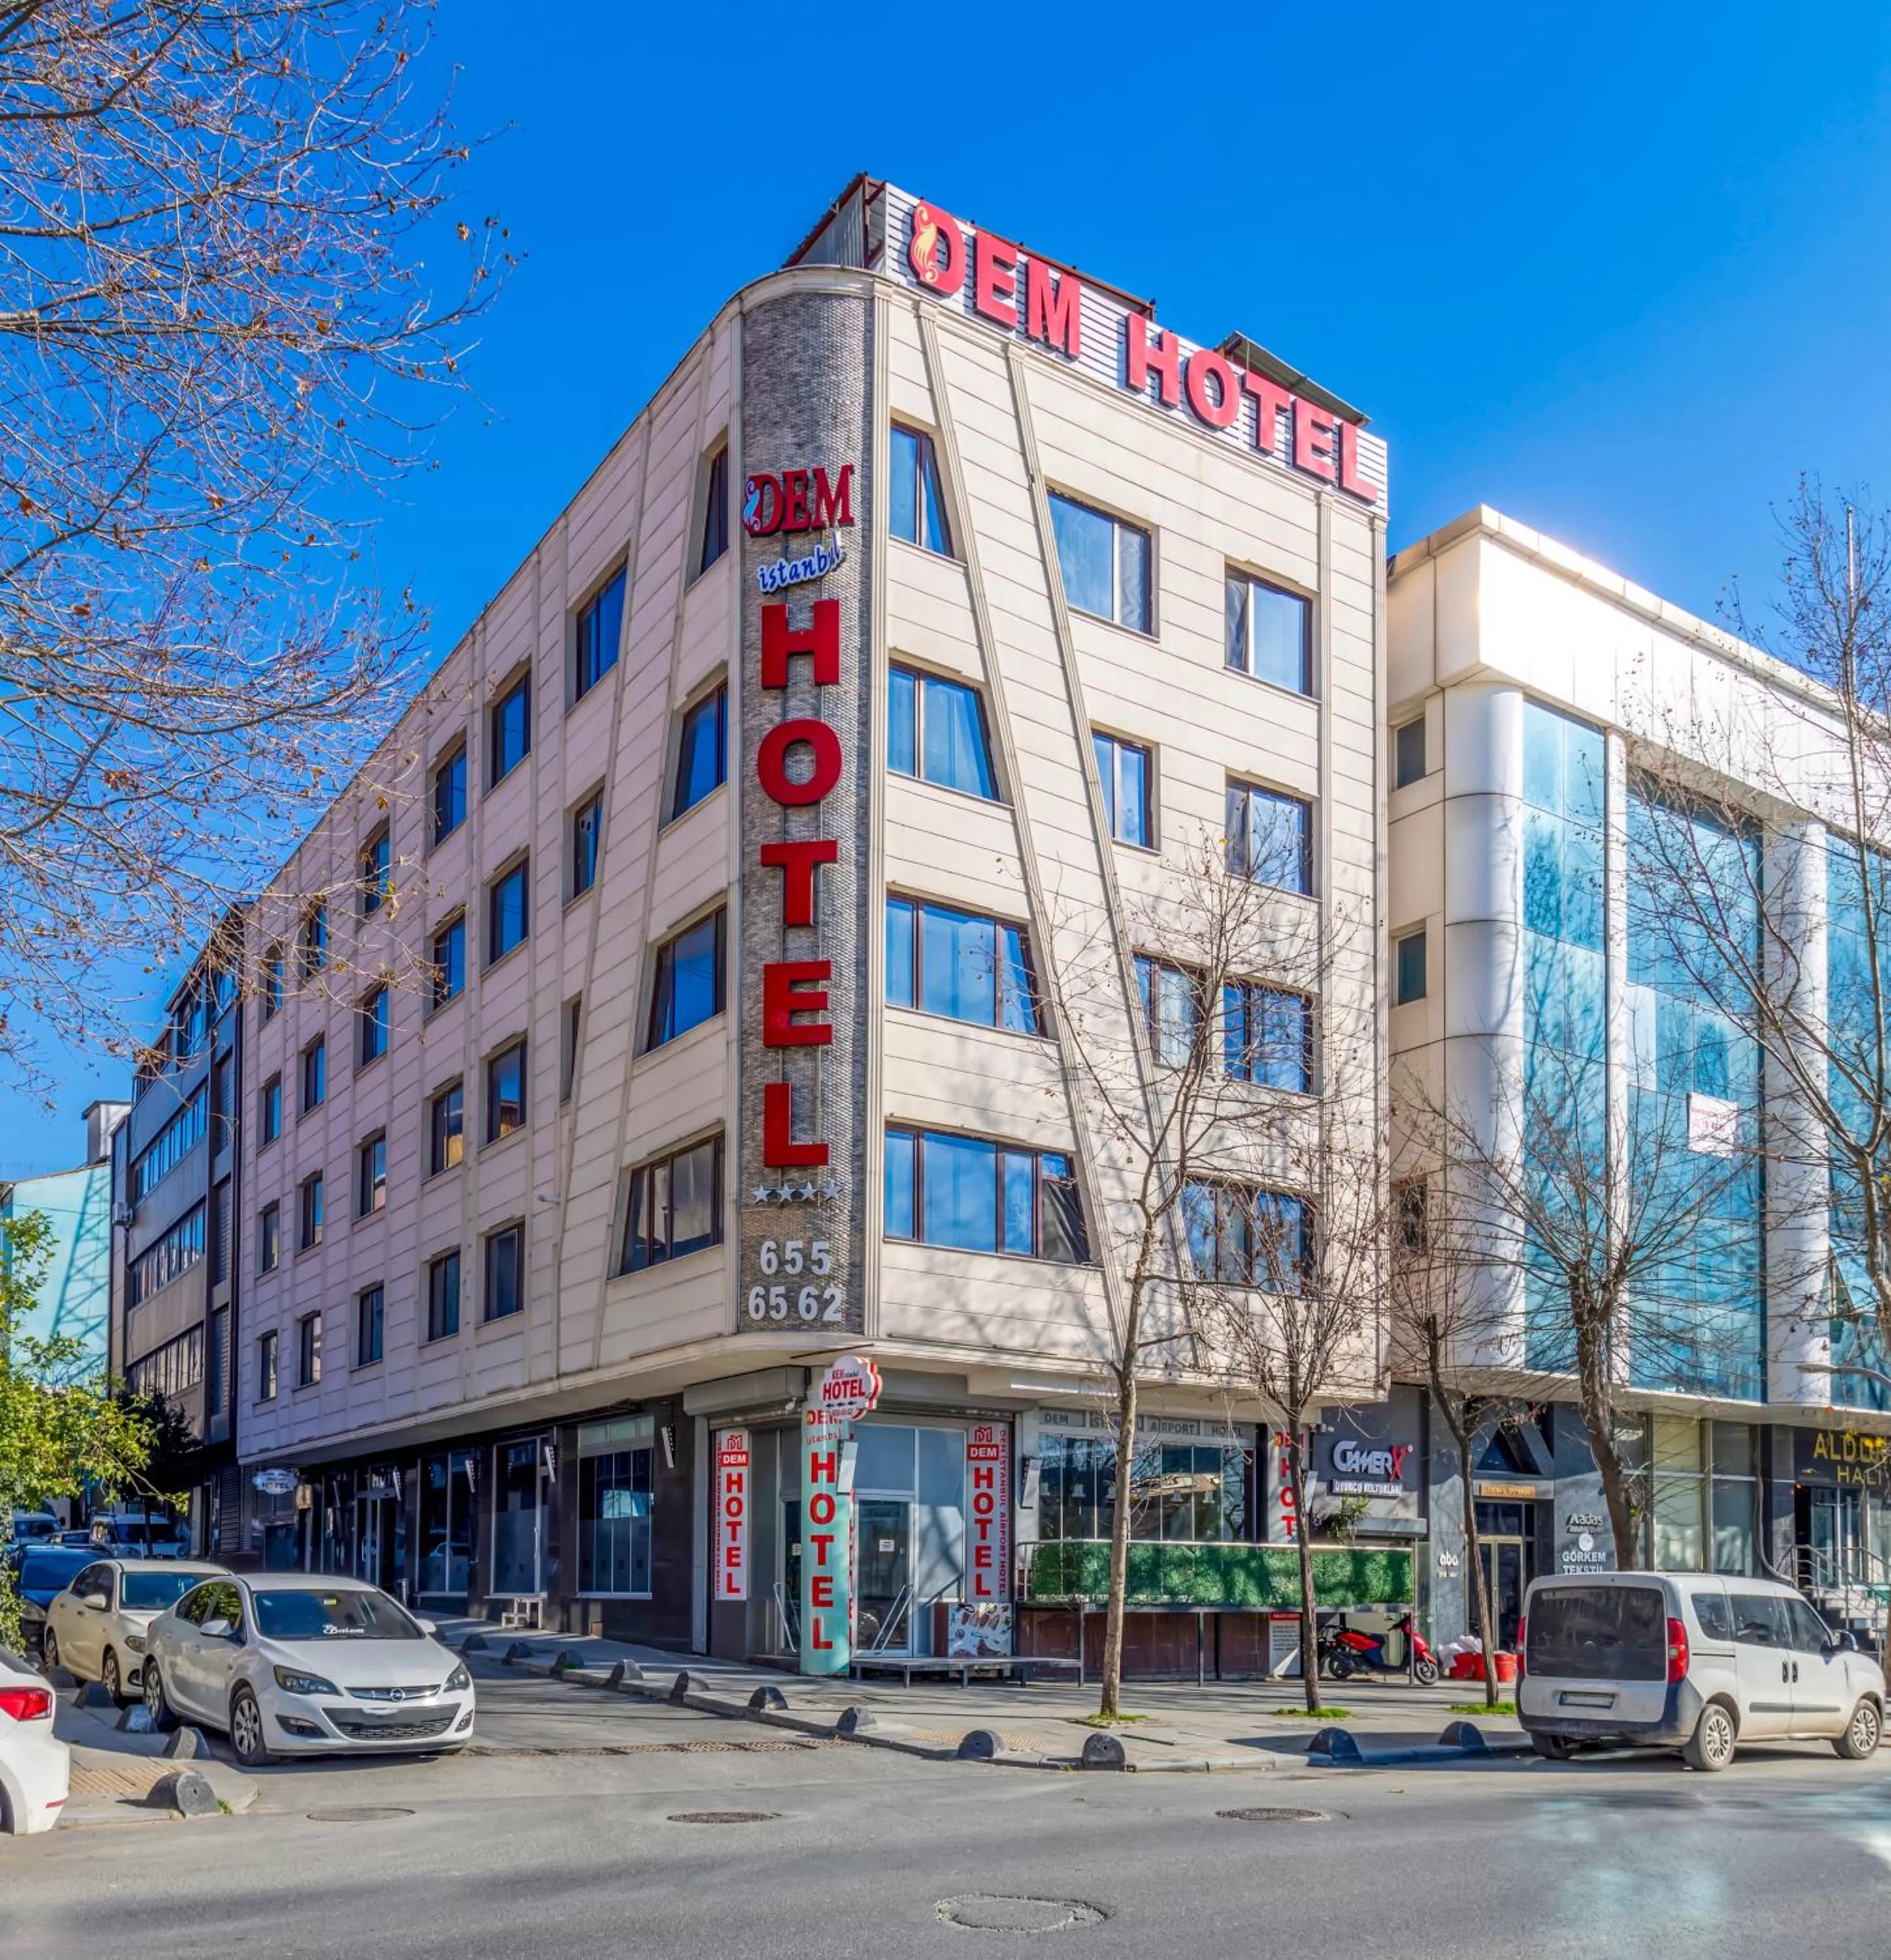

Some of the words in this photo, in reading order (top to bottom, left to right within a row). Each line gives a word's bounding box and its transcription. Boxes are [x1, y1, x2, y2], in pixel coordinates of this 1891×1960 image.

[908, 199, 1081, 361] DEM
[1126, 312, 1377, 504] HOTEL
[743, 463, 855, 538] DEM
[757, 599, 843, 1168] HOTEL
[760, 1240, 830, 1275] 655
[823, 1378, 865, 1401] HOTEL
[1045, 1413, 1068, 1425] DEM
[723, 1454, 746, 1464] DEM
[970, 1447, 997, 1458] DEM
[726, 1473, 743, 1593] HOTEL
[810, 1452, 836, 1649] HOTEL
[974, 1467, 993, 1595] HOTEL
[1562, 1550, 1606, 1562] GÖRKEM
